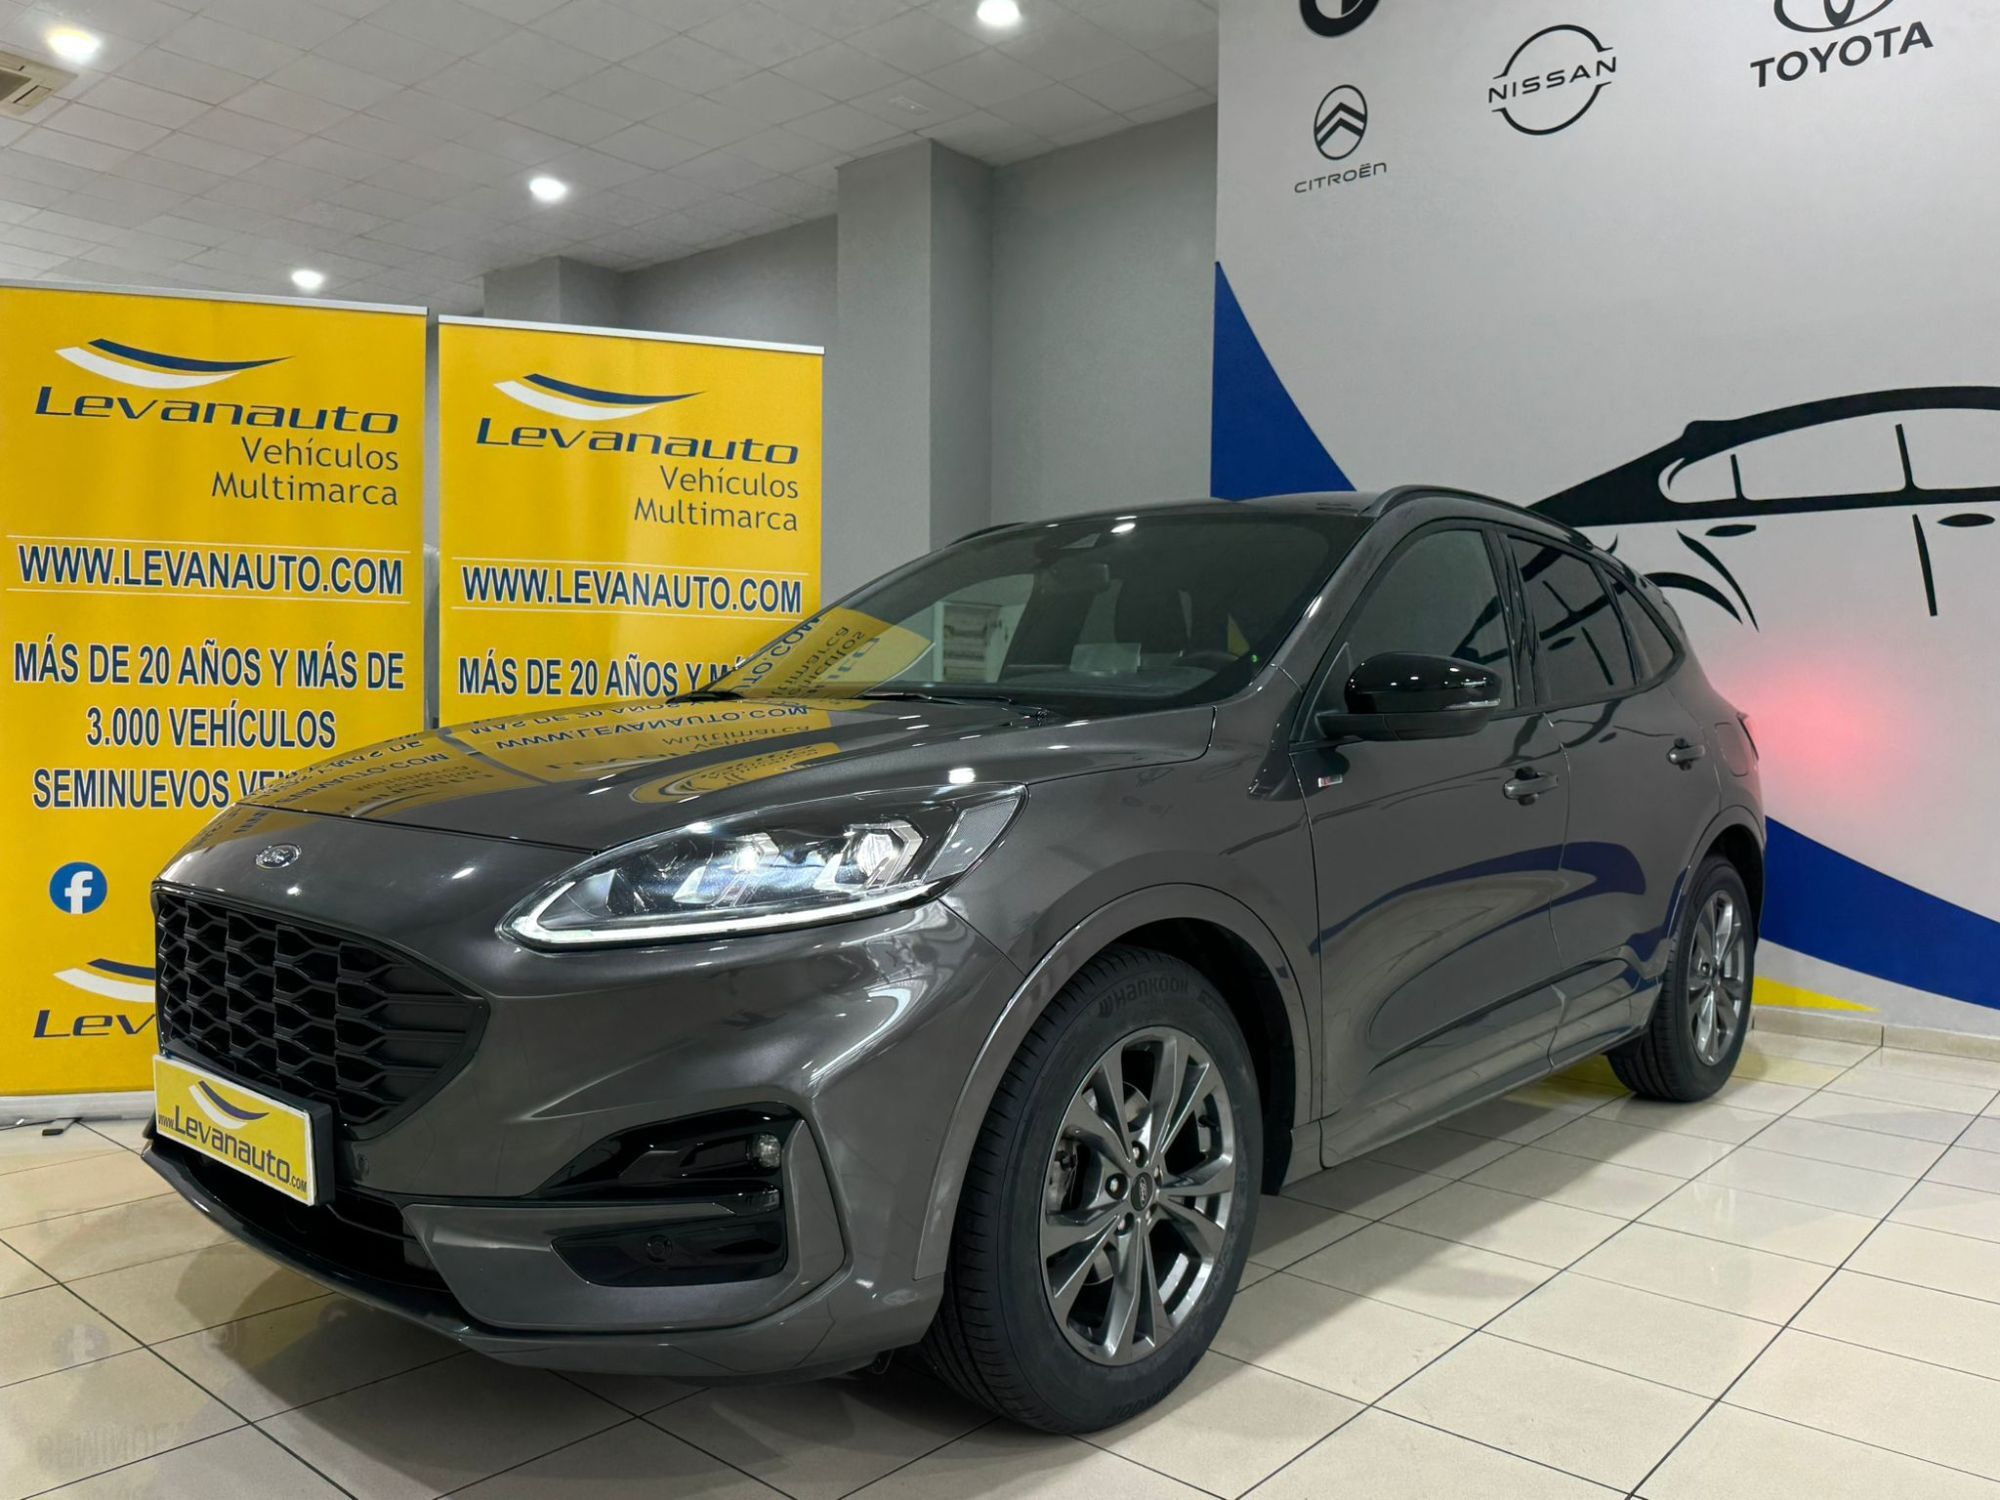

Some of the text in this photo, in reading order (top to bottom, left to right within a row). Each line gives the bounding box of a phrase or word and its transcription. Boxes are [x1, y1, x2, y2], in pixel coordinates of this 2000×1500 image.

[1750, 21, 1934, 88] TOYOTA
[1488, 56, 1617, 103] NISSAN
[1294, 162, 1387, 193] CITROËN
[34, 386, 398, 434] Levanauto
[241, 436, 399, 471] Vehículos
[476, 417, 799, 465] Levanauto
[211, 471, 398, 506] Multimarca
[660, 465, 799, 499] Vehículos
[634, 497, 798, 532] Multimarca
[17, 544, 402, 595] WWW.LEVANAUTO.COM
[461, 565, 801, 614] WWW.LEVANAUTO.COM
[14, 633, 405, 690] MÁS DE 20 AÑOS Y MÁS DE
[459, 649, 517, 694] MÁS
[527, 659, 561, 695] DE
[570, 660, 598, 696] 20
[605, 653, 678, 698] AÑOS
[686, 663, 702, 691] Y
[86, 700, 337, 749] 3.000 VEHÍCULOS
[32, 768, 230, 808] SEMINUEVOS
